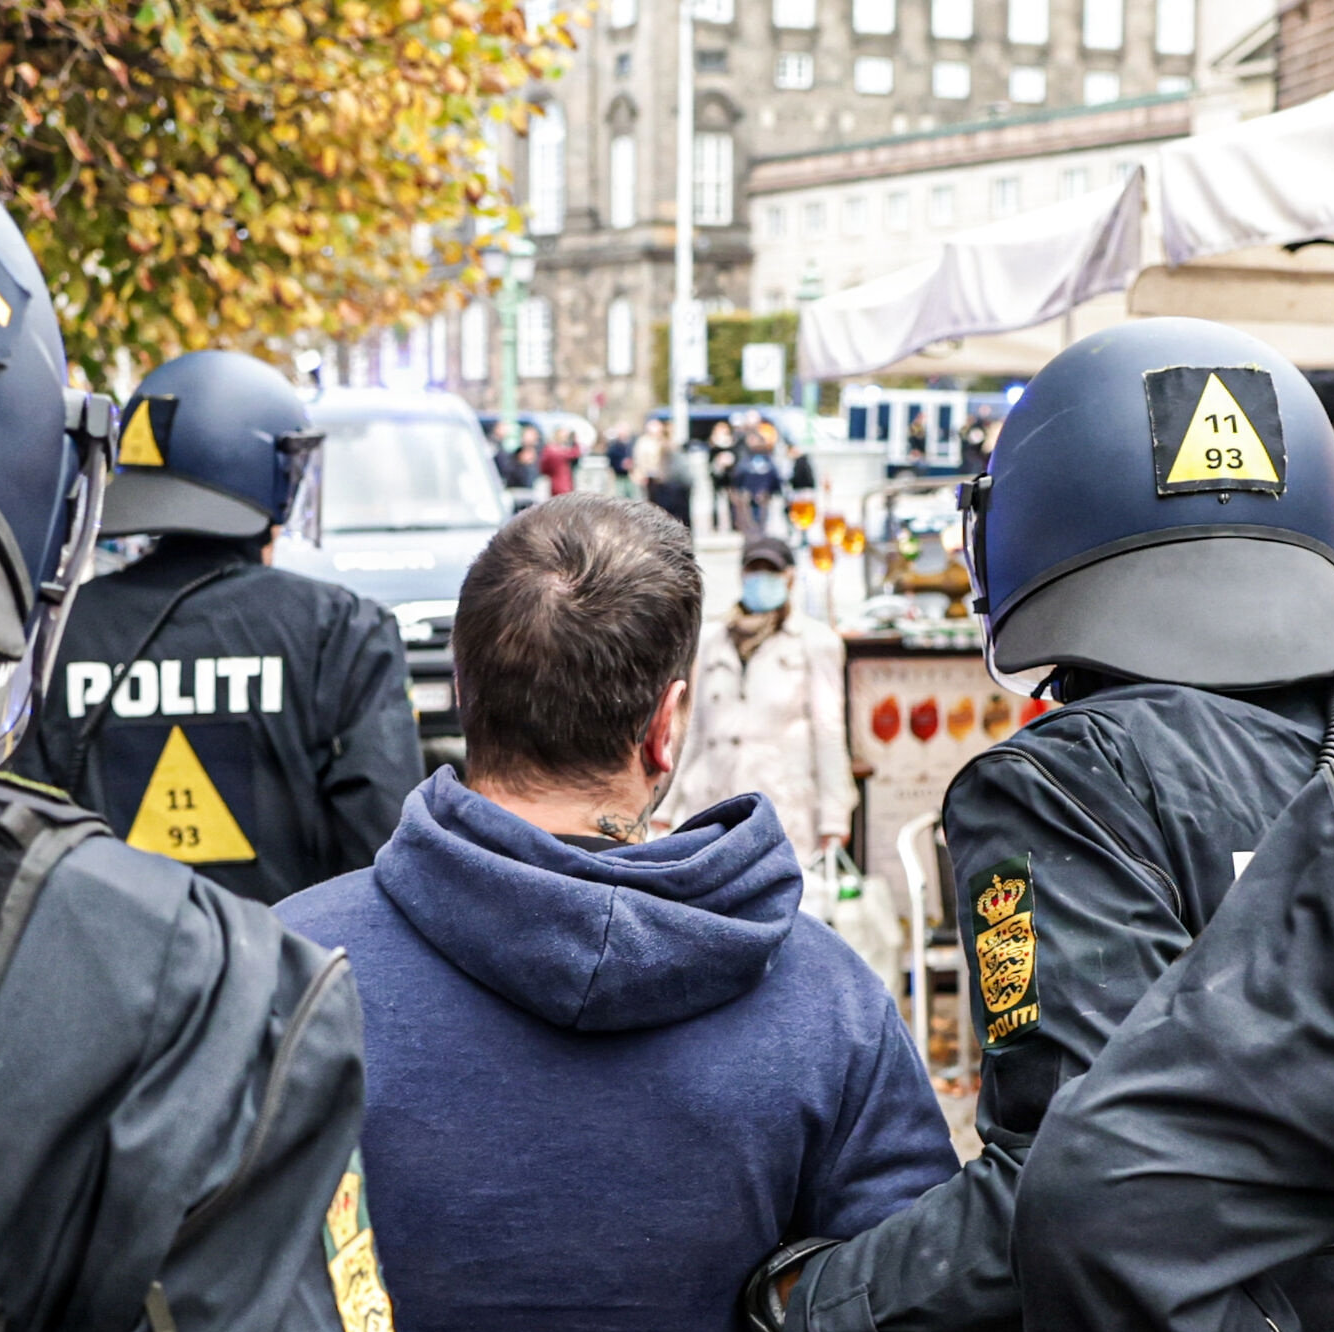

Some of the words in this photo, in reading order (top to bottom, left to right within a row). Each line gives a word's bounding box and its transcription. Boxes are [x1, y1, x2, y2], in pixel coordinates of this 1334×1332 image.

[1204, 413, 1238, 434] 11
[1205, 447, 1244, 470] 93
[67, 655, 283, 719] POLITI
[167, 788, 195, 810] 11
[168, 826, 201, 847] 93
[987, 1002, 1038, 1044] POLITI
